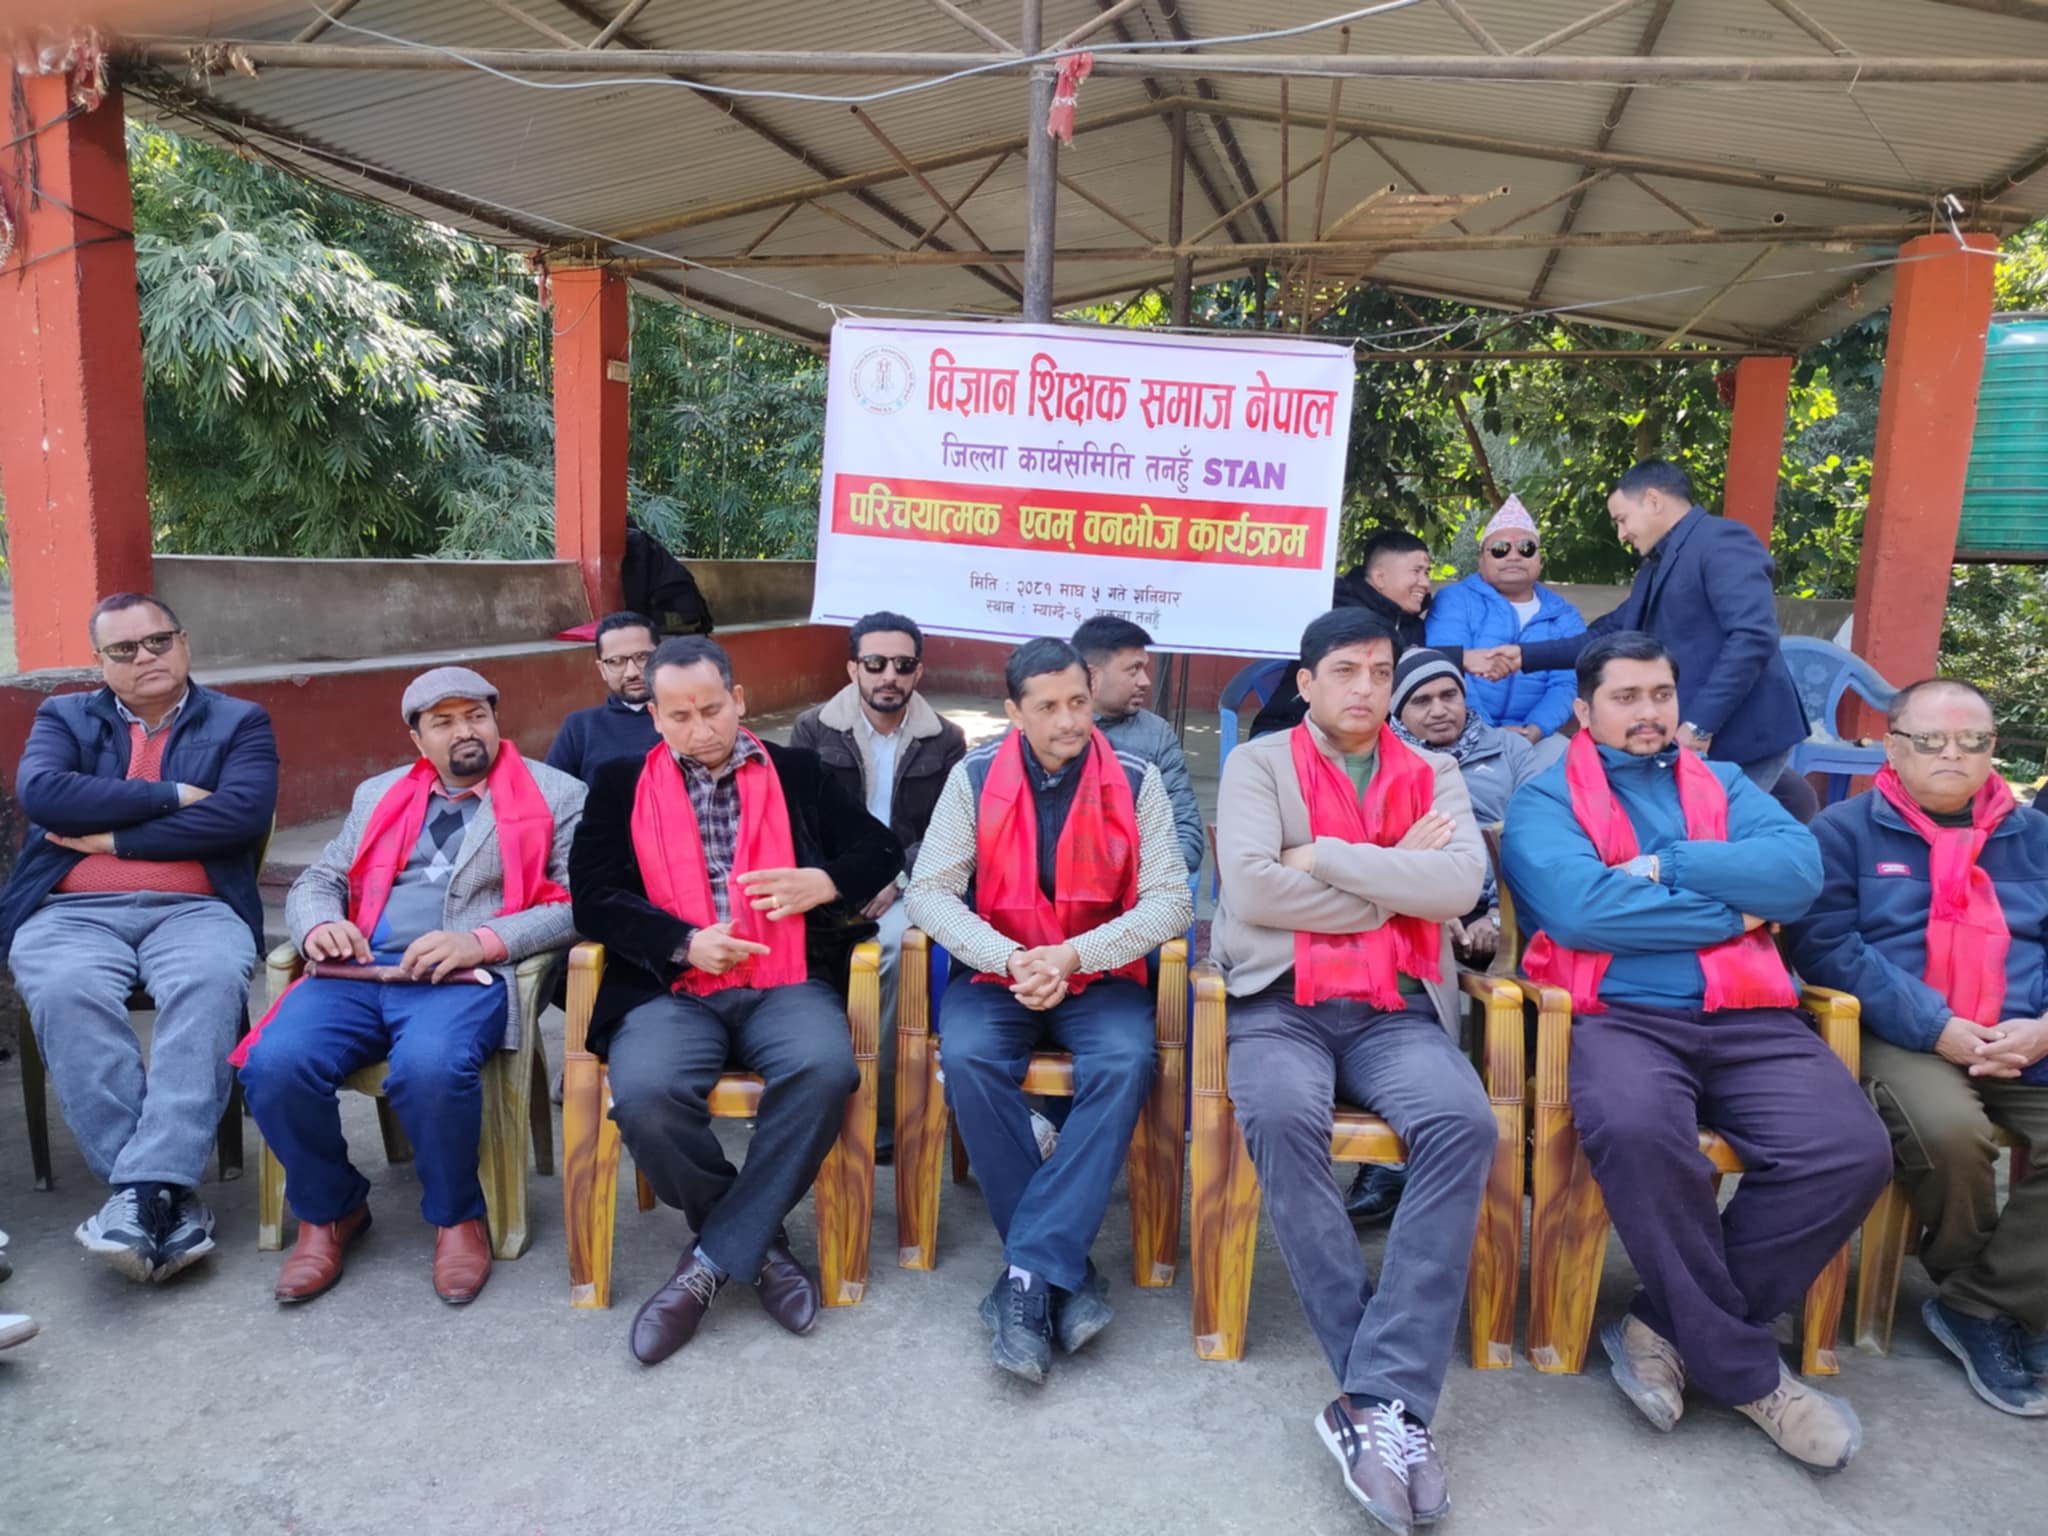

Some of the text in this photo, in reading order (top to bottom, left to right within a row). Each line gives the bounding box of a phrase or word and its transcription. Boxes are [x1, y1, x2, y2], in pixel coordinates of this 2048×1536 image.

[928, 347, 1020, 417] विज्ञान
[1028, 352, 1130, 427] शिक्षक
[1139, 379, 1236, 429] समाज
[1245, 370, 1338, 439] नेपाल
[941, 432, 1286, 494] जिल्ला कार्यसमिति तनहुँ STAN
[849, 482, 1310, 558] परिचयात्मक एवम् वनभोज कार्यक्रम
[970, 571, 998, 590] मिति
[1017, 580, 1052, 597] २०८१
[1060, 583, 1086, 598] माघ
[1092, 586, 1100, 602] ५
[1108, 584, 1127, 601] गते
[1133, 584, 1182, 607] शनिवार
